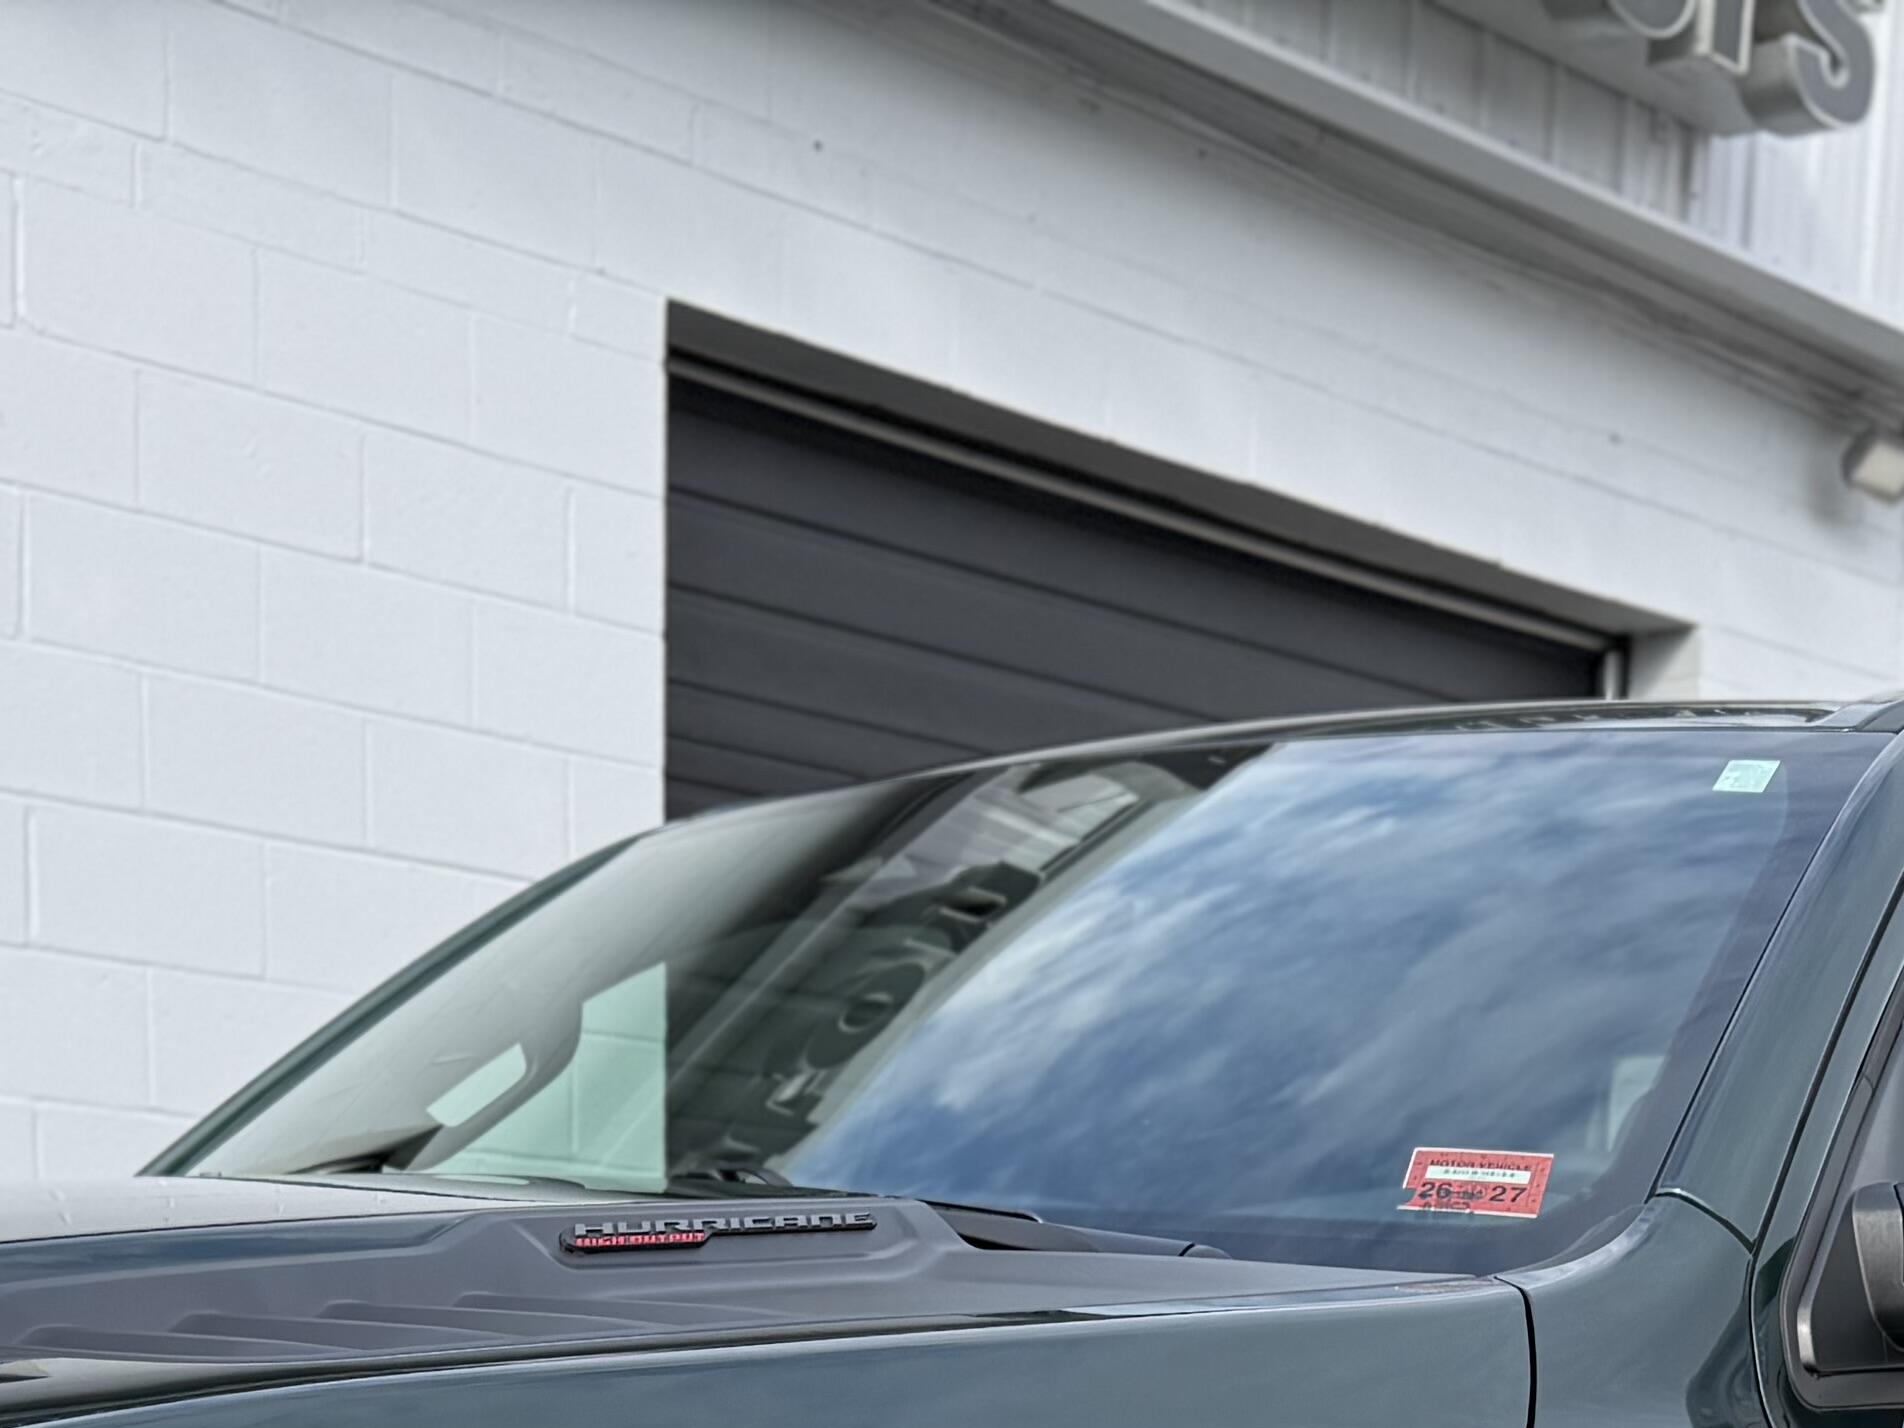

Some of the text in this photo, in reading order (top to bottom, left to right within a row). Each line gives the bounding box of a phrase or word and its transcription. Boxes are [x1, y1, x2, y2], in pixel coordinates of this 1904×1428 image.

[1430, 1159, 1532, 1170] MOTOR VEHICLE
[1418, 1182, 1452, 1200] 26
[1489, 1185, 1527, 1203] 27
[574, 1211, 873, 1237] HURRICANE
[575, 1232, 705, 1248] HIGH OUTPUT
